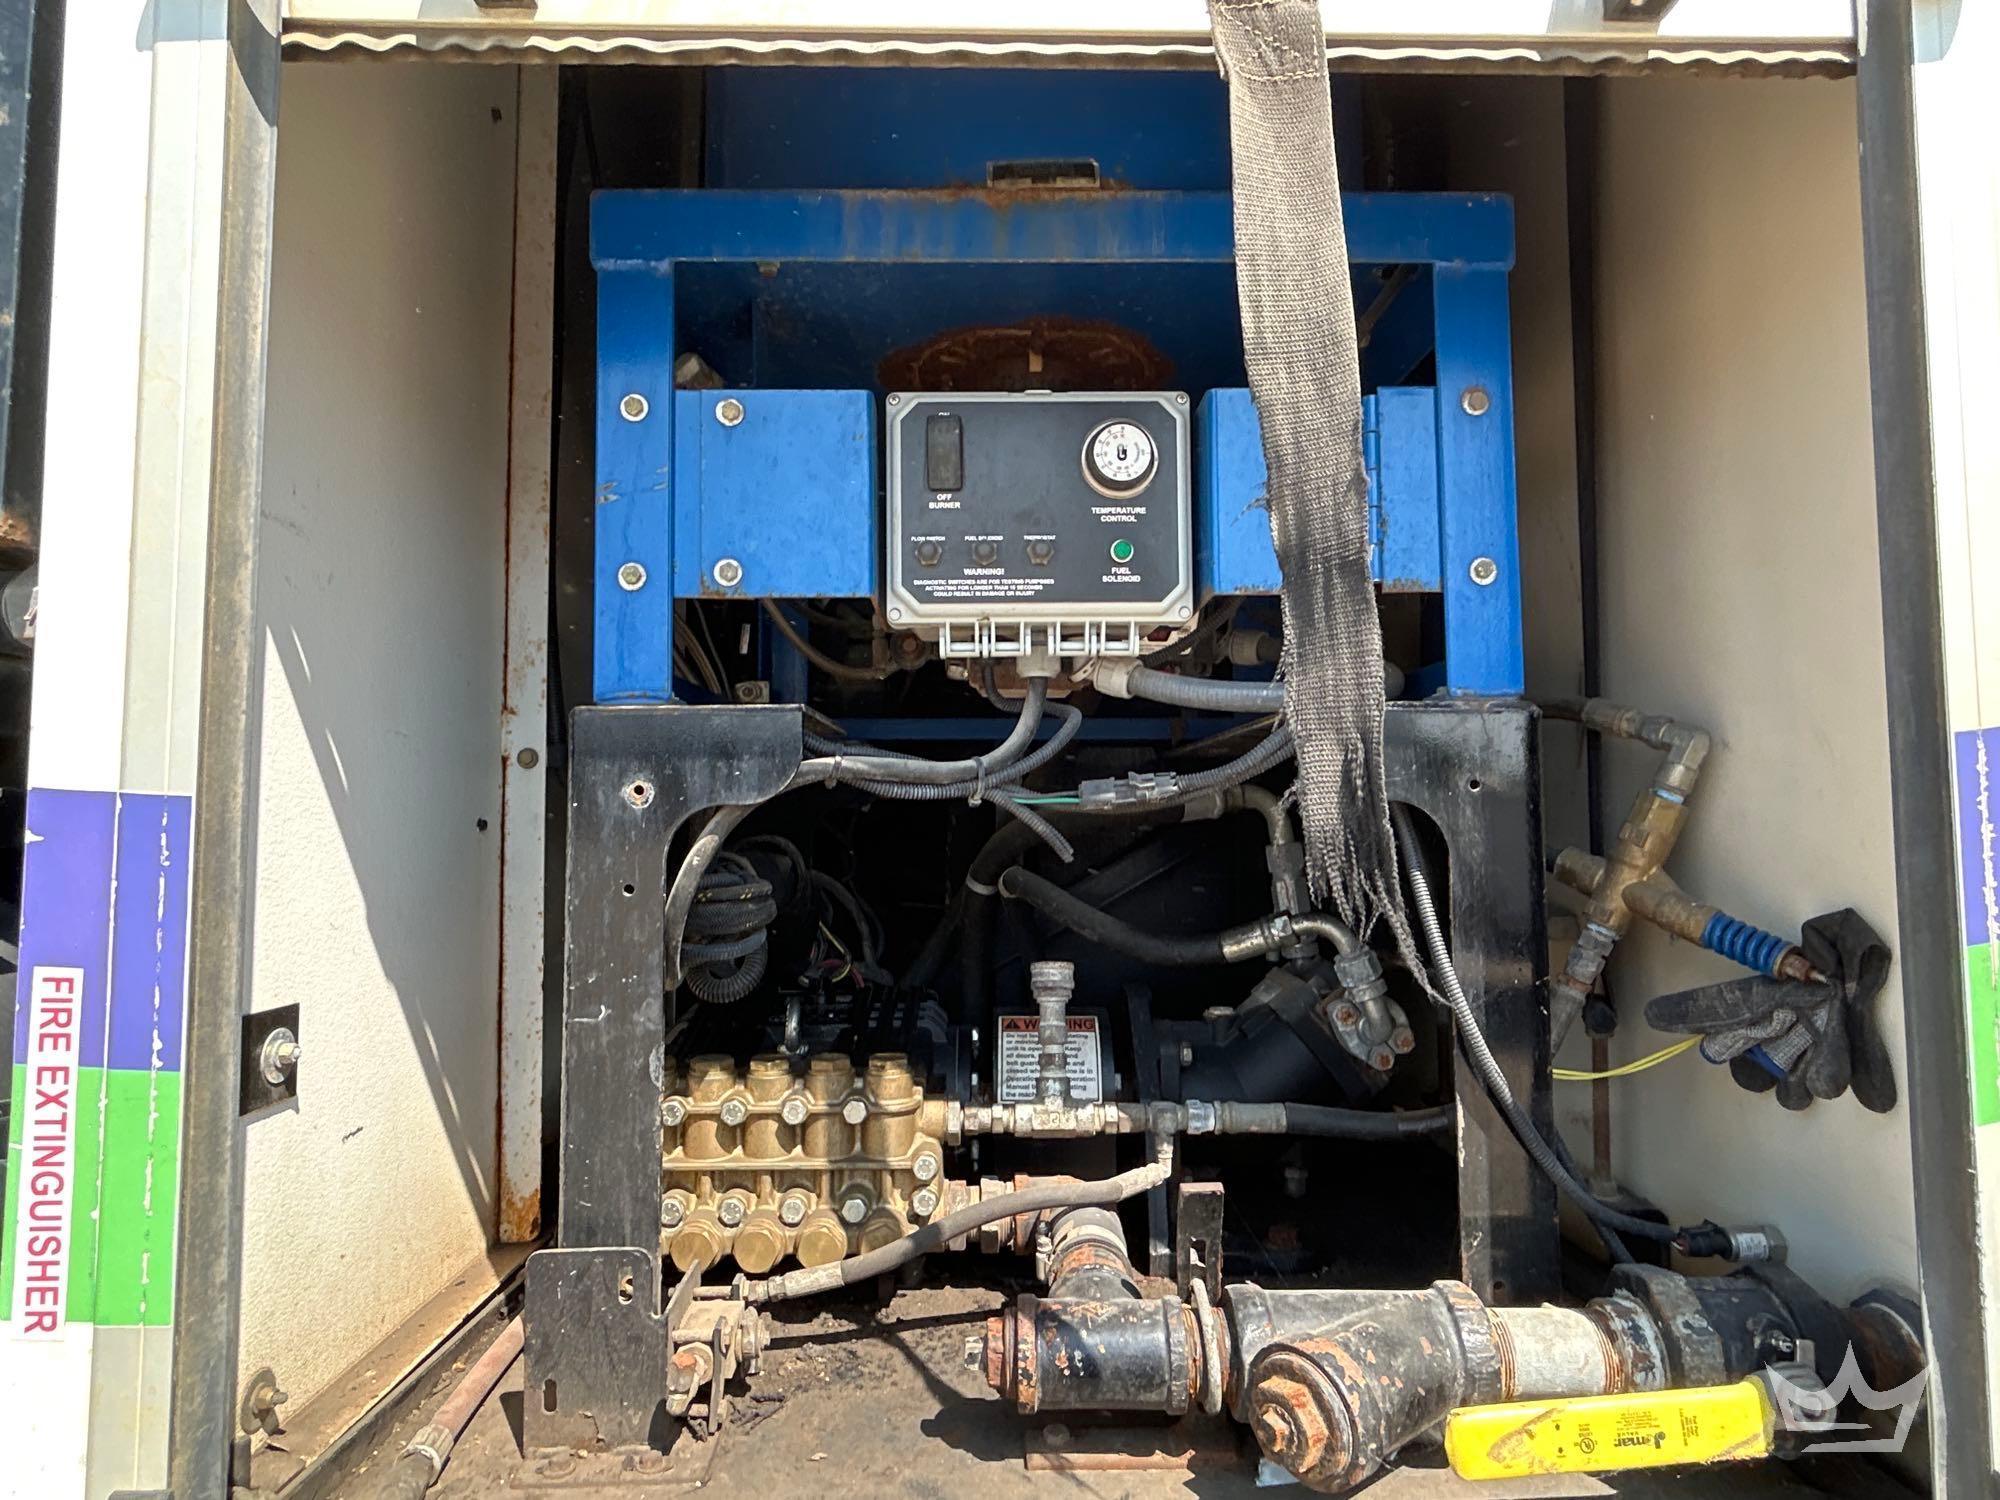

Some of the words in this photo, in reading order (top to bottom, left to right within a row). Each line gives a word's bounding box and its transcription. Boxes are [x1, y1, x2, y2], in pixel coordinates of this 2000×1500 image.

[963, 568, 1005, 576] WARNING!
[1111, 566, 1132, 574] FUEL
[39, 977, 74, 1052] FIRE
[1024, 1020, 1094, 1029] WING
[24, 1065, 70, 1334] EXTINGUISHER
